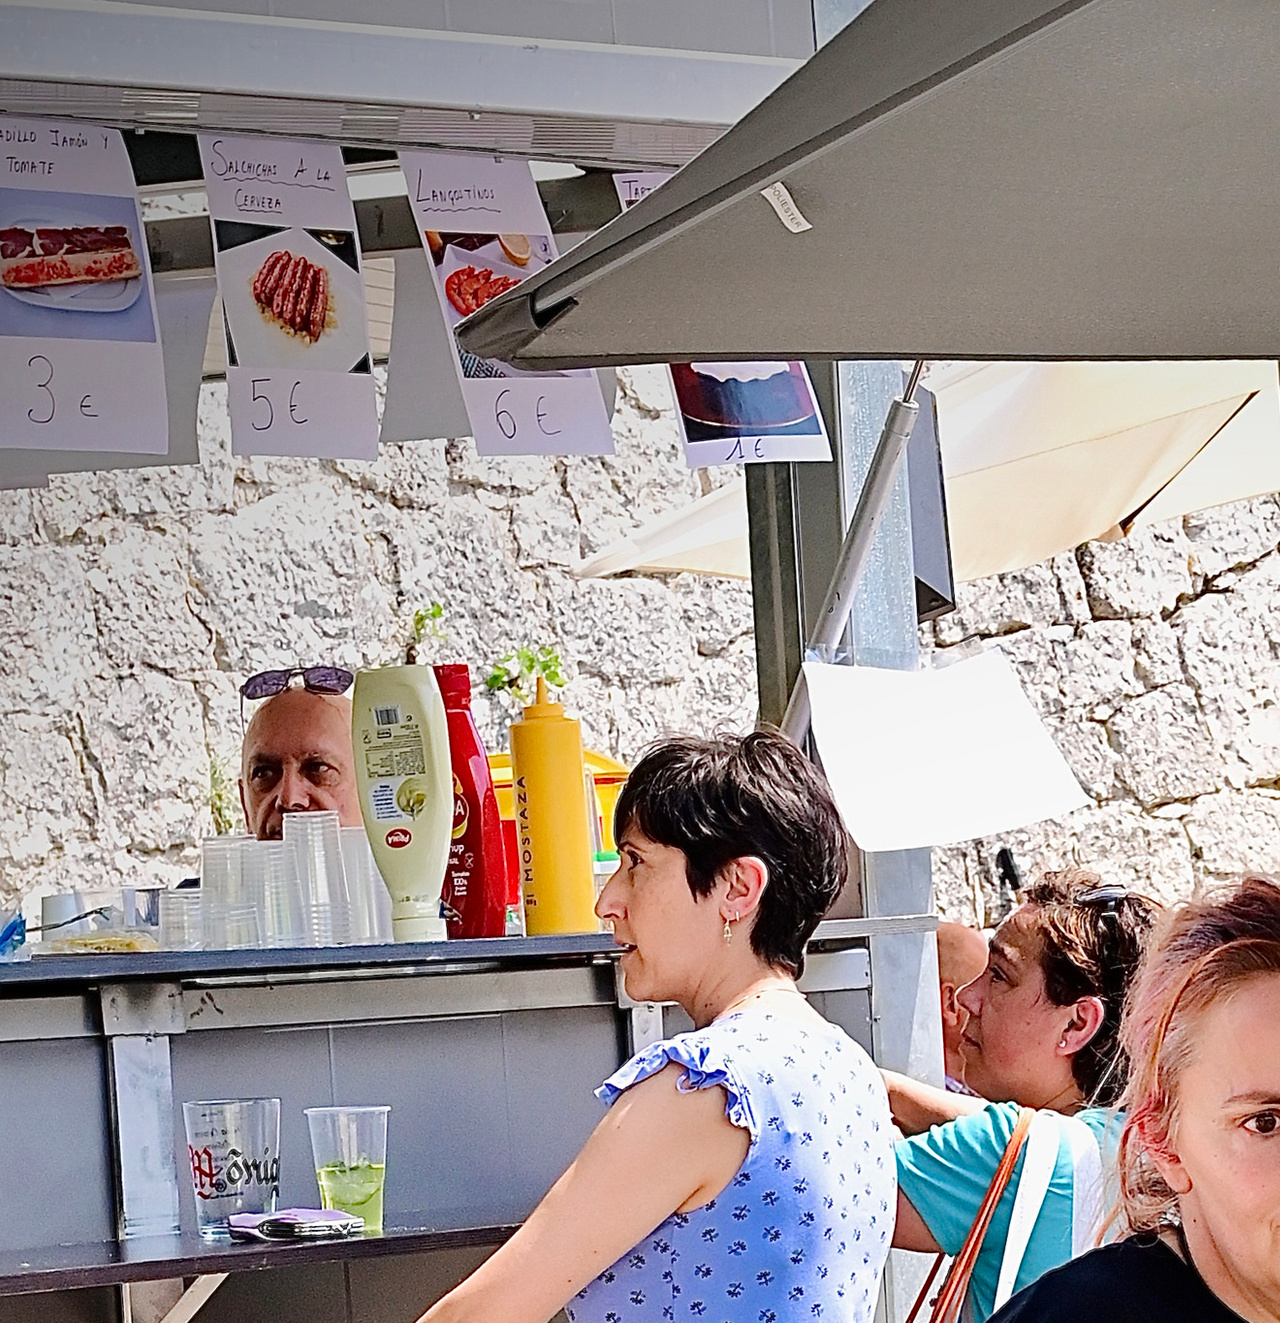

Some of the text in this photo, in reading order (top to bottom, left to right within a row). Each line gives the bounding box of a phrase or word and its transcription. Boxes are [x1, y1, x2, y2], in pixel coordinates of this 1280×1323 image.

[101, 134, 109, 149] Y
[211, 140, 331, 181] SALCHICHAS A LA
[6, 156, 55, 175] TOMATE
[235, 188, 281, 208] CERVEZA
[416, 168, 495, 206] LANGOSTINOS
[770, 184, 802, 228] POLIESTER
[27, 355, 98, 424] 3 €
[251, 378, 308, 431] 5 €
[495, 389, 562, 440] 6 €
[725, 438, 766, 461] 1 €
[517, 776, 534, 882] MOSTAZA
